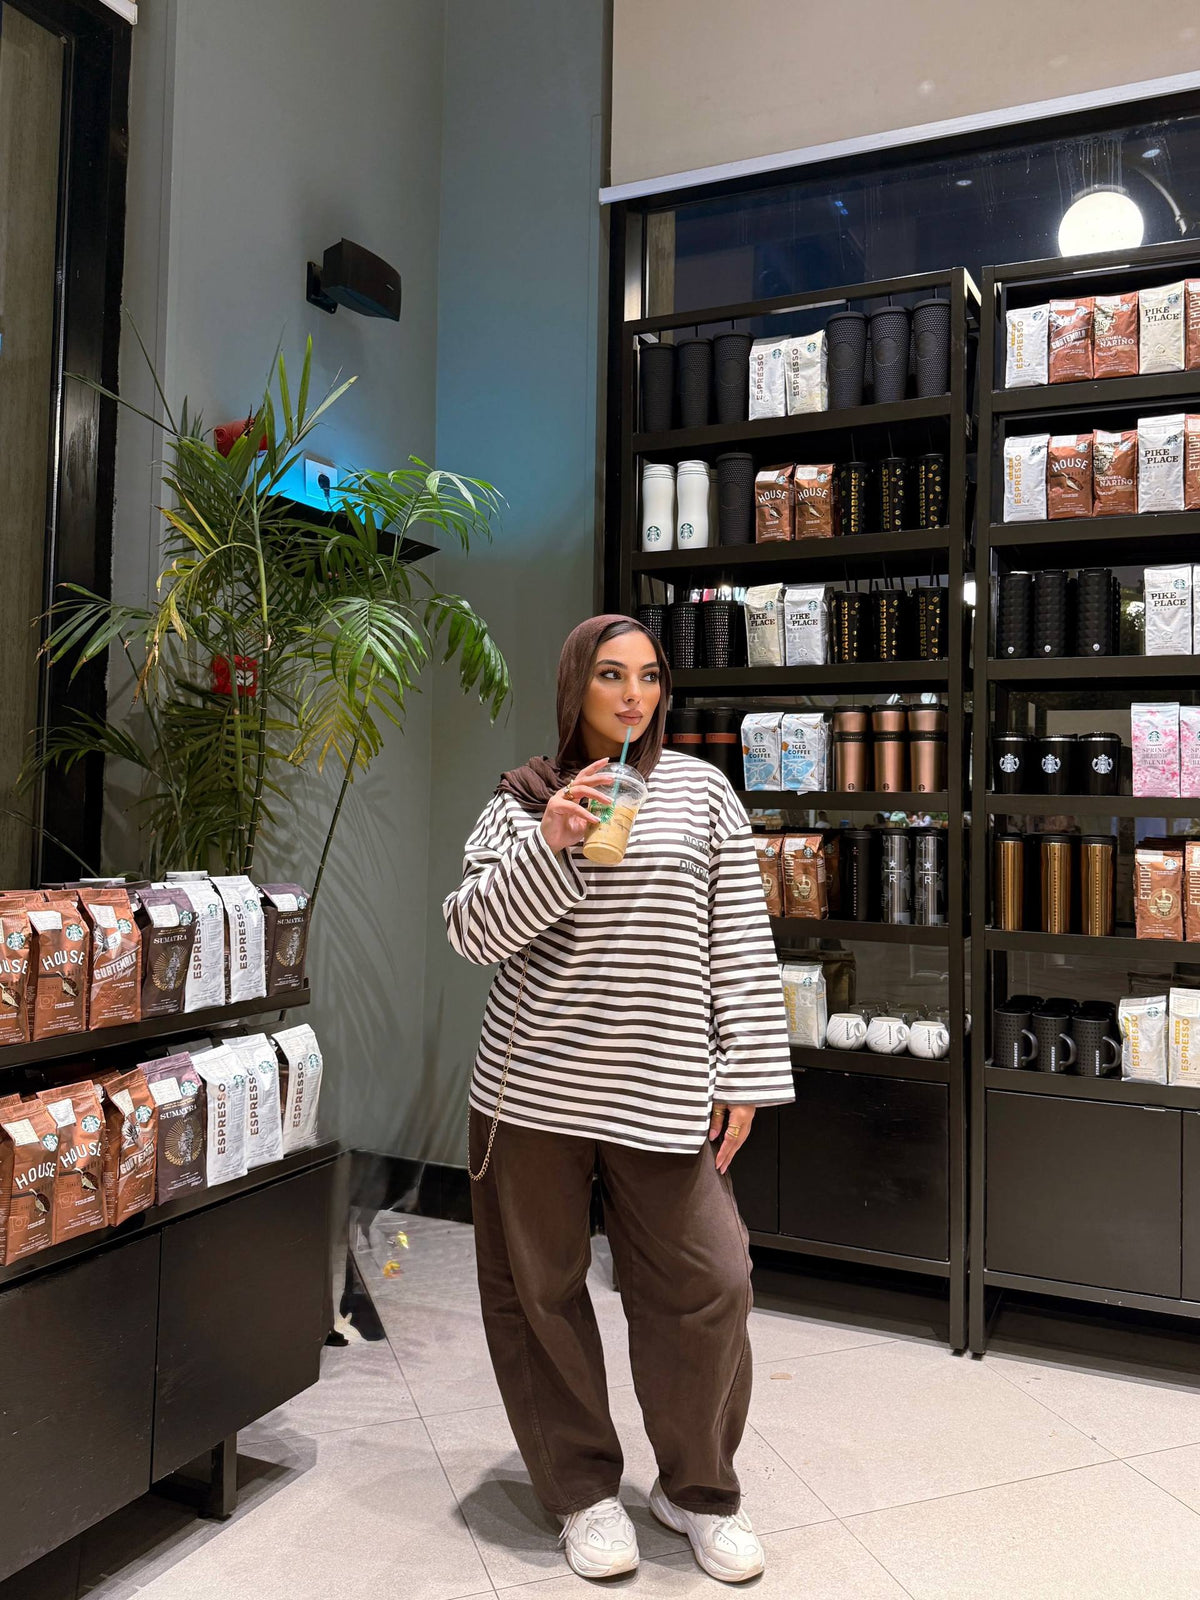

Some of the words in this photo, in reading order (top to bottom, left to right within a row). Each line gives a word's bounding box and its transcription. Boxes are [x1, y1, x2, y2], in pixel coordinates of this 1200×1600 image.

[1145, 306, 1170, 317] PIKE
[1147, 313, 1179, 323] PLACE
[1016, 320, 1024, 369] ESPRESSO
[756, 353, 764, 401] ESPRESSO
[792, 348, 800, 397] ESPRESSO
[1144, 448, 1170, 458] PIKE
[1147, 455, 1179, 464] PLACE
[1052, 458, 1089, 472] HOUSE
[1014, 455, 1022, 504] ESPRESSO
[758, 489, 788, 503] HOUSE
[798, 487, 829, 500] HOUSE
[851, 472, 859, 532] STARBUCKS
[1151, 592, 1177, 600] PIKE
[1154, 599, 1187, 607] PLACE
[751, 619, 775, 627] PLACE
[792, 619, 818, 627] PLACE
[841, 601, 849, 660] STARBUCKS
[889, 874, 897, 883] R
[925, 875, 932, 885] R
[1140, 861, 1151, 900] ETHIOPI
[153, 934, 187, 944] SUMATRA
[235, 904, 247, 970] ESPRESSO
[0, 959, 28, 974] USE
[42, 949, 85, 971] HOUSE
[1131, 1015, 1139, 1067] ESPRESSO
[1181, 1018, 1190, 1071] ESPRESSO
[293, 1062, 304, 1129] ESPRESSO
[217, 1083, 226, 1155] ESPRESSO
[60, 1142, 101, 1168] HOUSE
[15, 1162, 56, 1190] HOUSE
